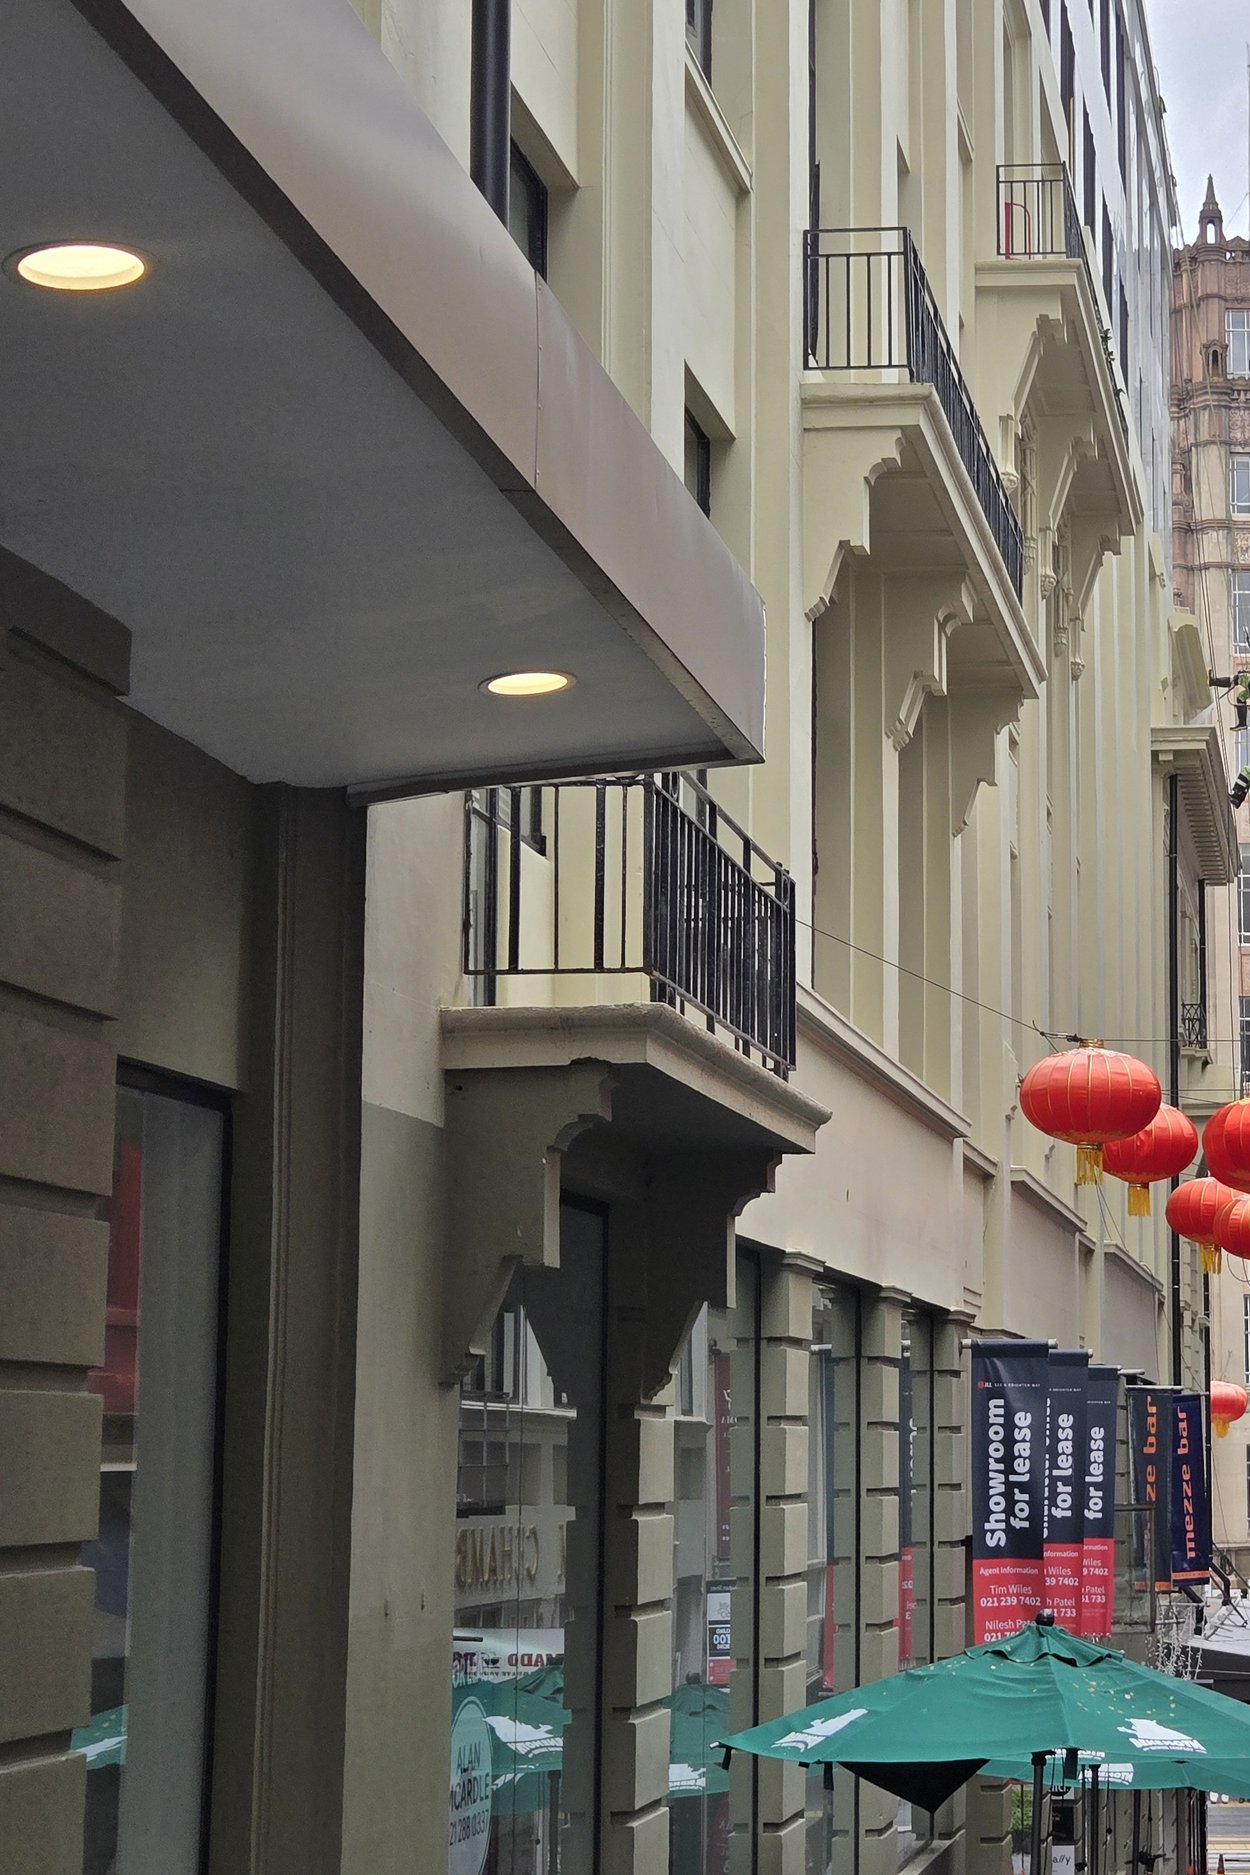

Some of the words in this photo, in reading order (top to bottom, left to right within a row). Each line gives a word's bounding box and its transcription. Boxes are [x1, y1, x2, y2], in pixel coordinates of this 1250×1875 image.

[1143, 1396, 1157, 1455] bar
[1177, 1406, 1189, 1455] bar
[1009, 1411, 1032, 1482] lease
[1052, 1413, 1074, 1476] lease
[1085, 1426, 1105, 1482] lease
[984, 1398, 1006, 1547] Showroom
[1010, 1486, 1029, 1529] for
[1051, 1481, 1072, 1519] for
[1084, 1486, 1103, 1520] for
[1181, 1464, 1196, 1560] mezze
[980, 1567, 1000, 1576] Agent
[1001, 1566, 1039, 1575] Information
[1048, 1566, 1072, 1576] Wiles
[1089, 1567, 1109, 1575] 7402
[990, 1585, 1007, 1594] Tim
[1008, 1584, 1032, 1594] Wiles
[1045, 1577, 1056, 1586] 39
[1058, 1577, 1079, 1586] 7402
[1085, 1585, 1105, 1594] Patel
[980, 1597, 998, 1607] 021
[1000, 1597, 1017, 1606] 239
[1019, 1596, 1041, 1606] 7402
[1053, 1597, 1075, 1607] Patel
[1091, 1595, 1106, 1603] 733
[1060, 1608, 1076, 1617] 733
[985, 1620, 1014, 1630] Nilesh
[1015, 1619, 1037, 1630] Pate
[984, 1632, 1002, 1642] 021
[456, 1741, 481, 1774] ALAN
[449, 1821, 457, 1847] 21
